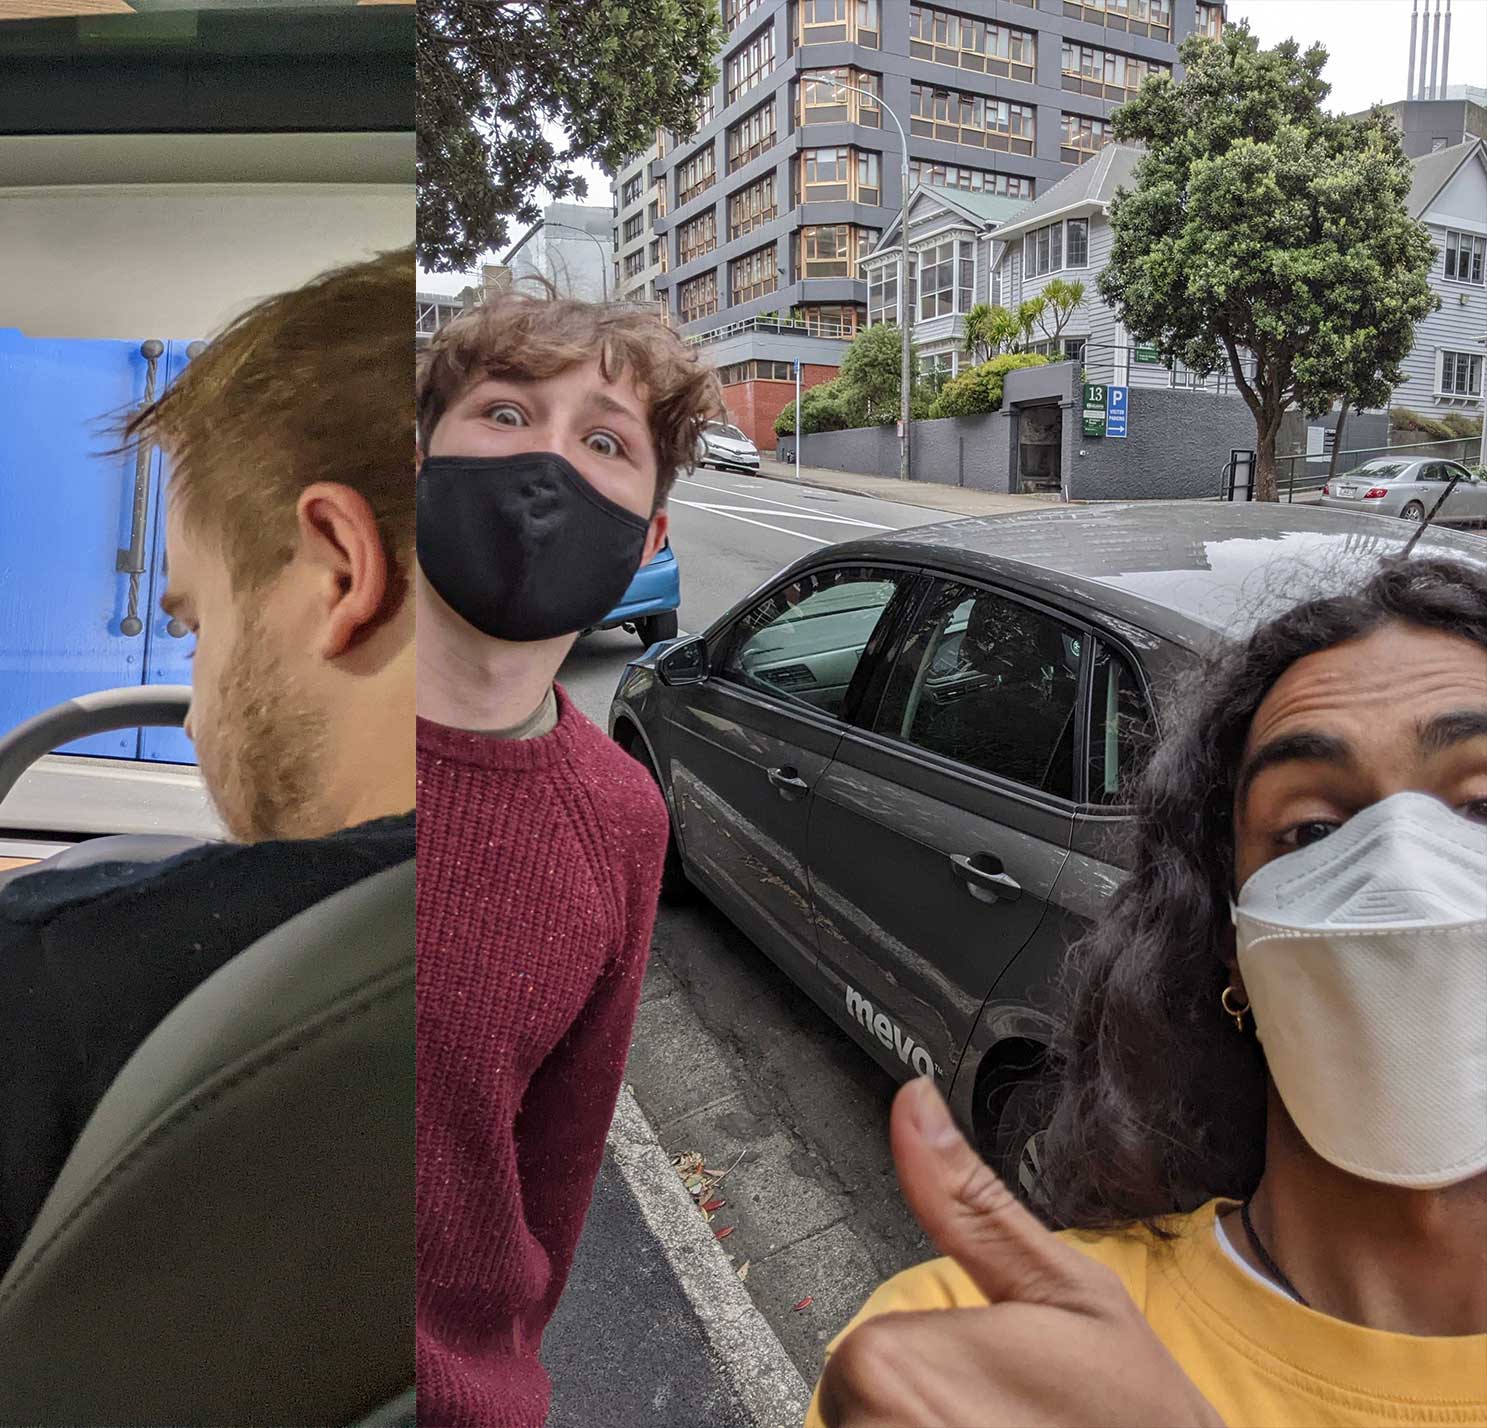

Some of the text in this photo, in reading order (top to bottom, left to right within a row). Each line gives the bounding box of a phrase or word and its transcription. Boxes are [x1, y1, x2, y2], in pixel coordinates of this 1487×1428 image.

[1089, 387, 1102, 401] 13
[1113, 390, 1123, 406] P
[845, 985, 934, 1078] mevo
